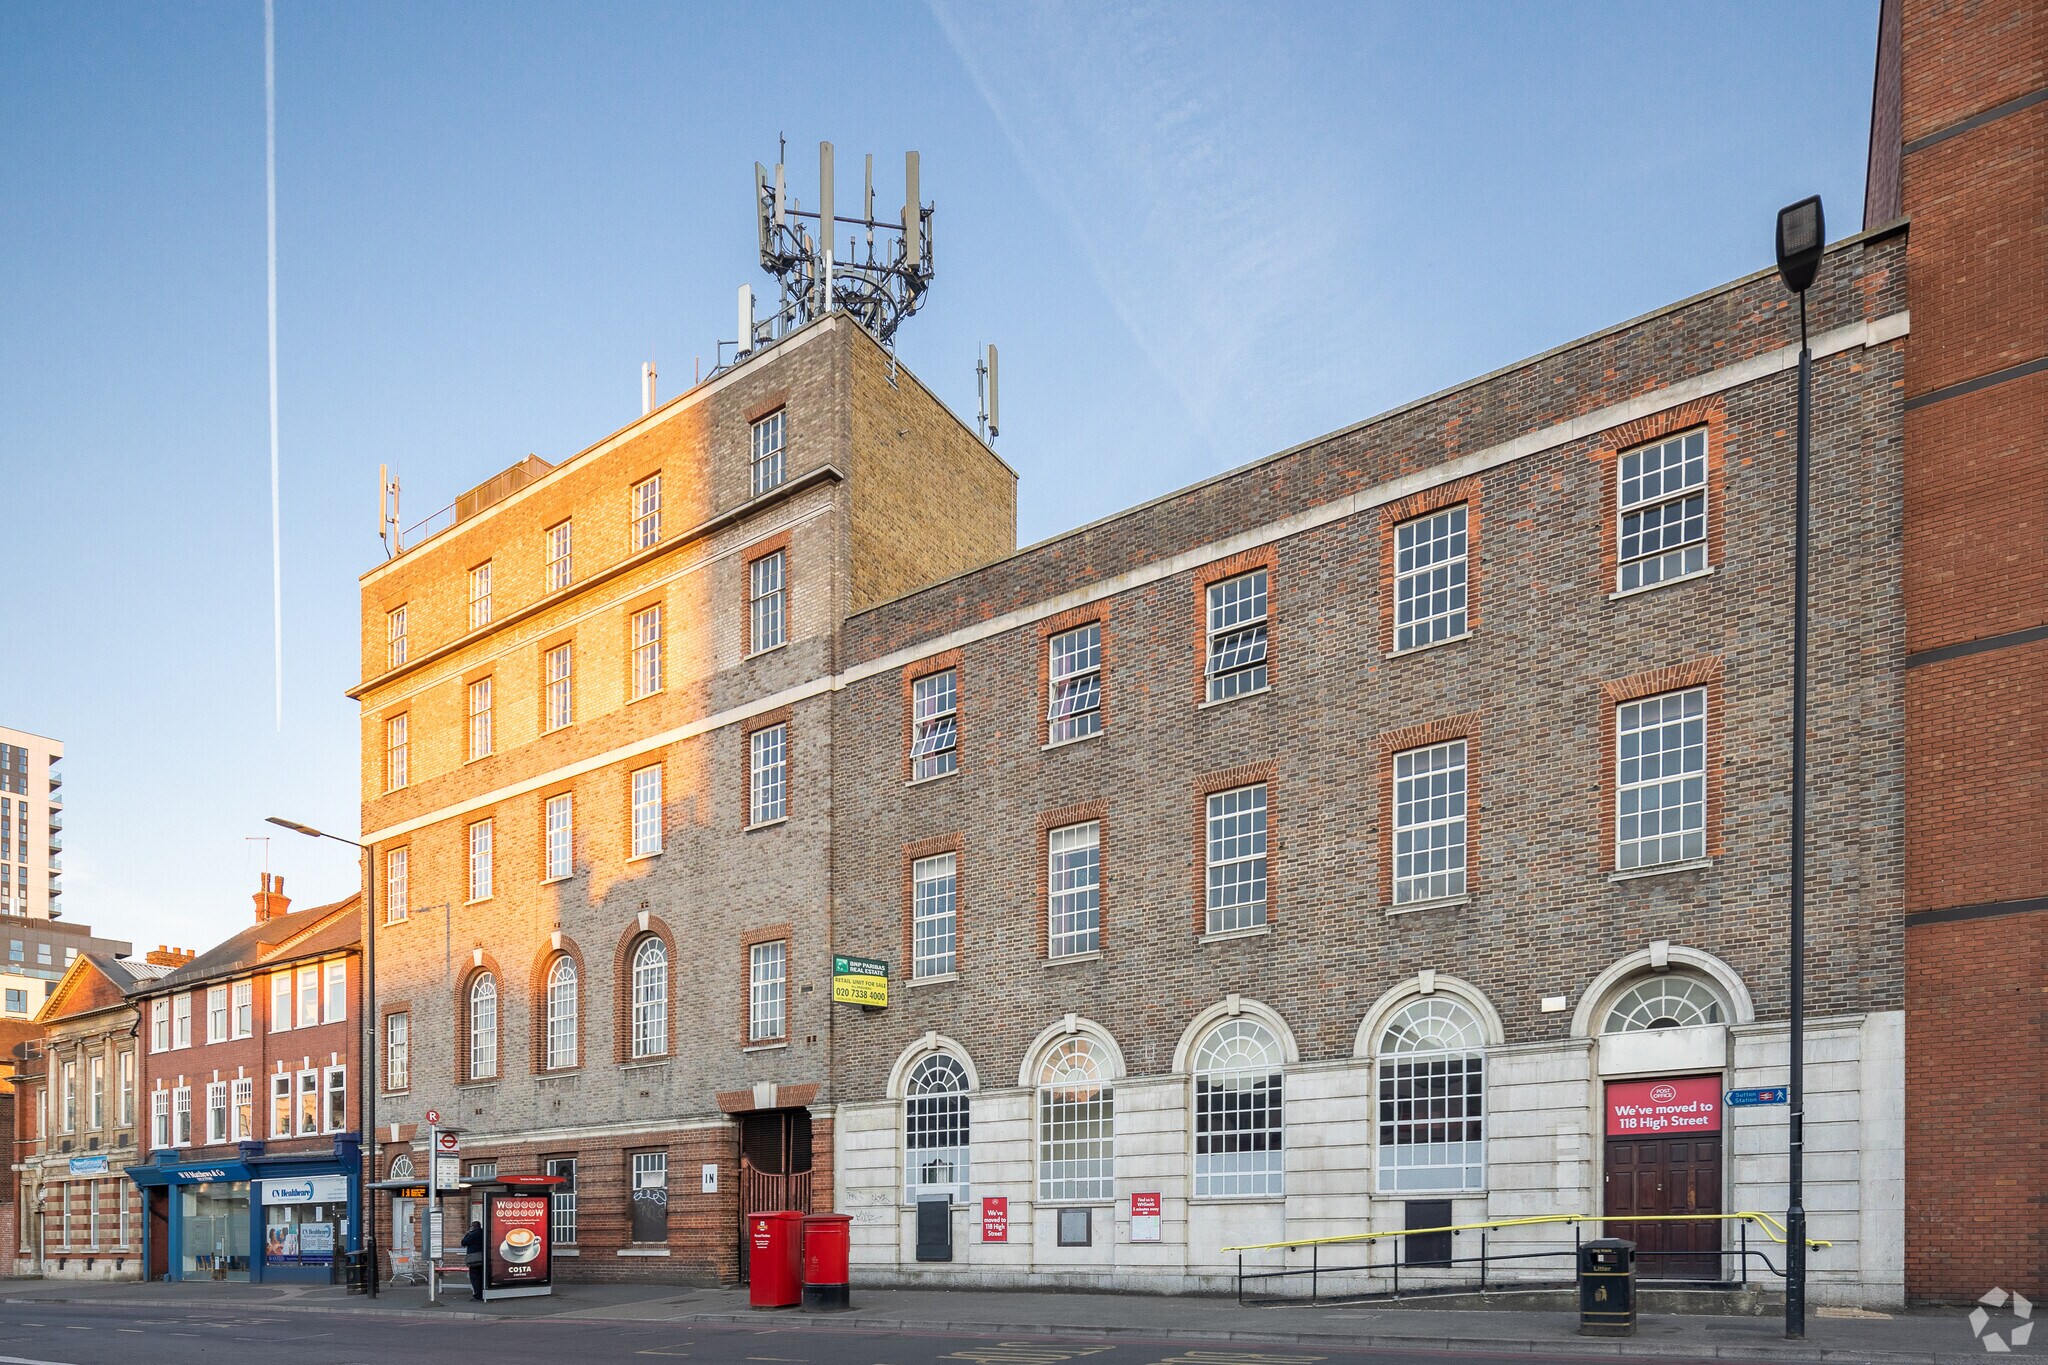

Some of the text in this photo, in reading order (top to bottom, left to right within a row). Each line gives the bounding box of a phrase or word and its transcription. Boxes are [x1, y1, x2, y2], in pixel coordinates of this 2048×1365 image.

[863, 963, 886, 971] PARIBAS
[836, 988, 850, 996] 020
[851, 989, 868, 998] 7338
[870, 992, 886, 1000] 4000
[1615, 1101, 1713, 1116] We've moved to
[430, 1112, 437, 1120] R
[1620, 1116, 1708, 1130] 118 High Street
[706, 1174, 714, 1184] IN
[272, 1188, 311, 1198] CN Healthcare
